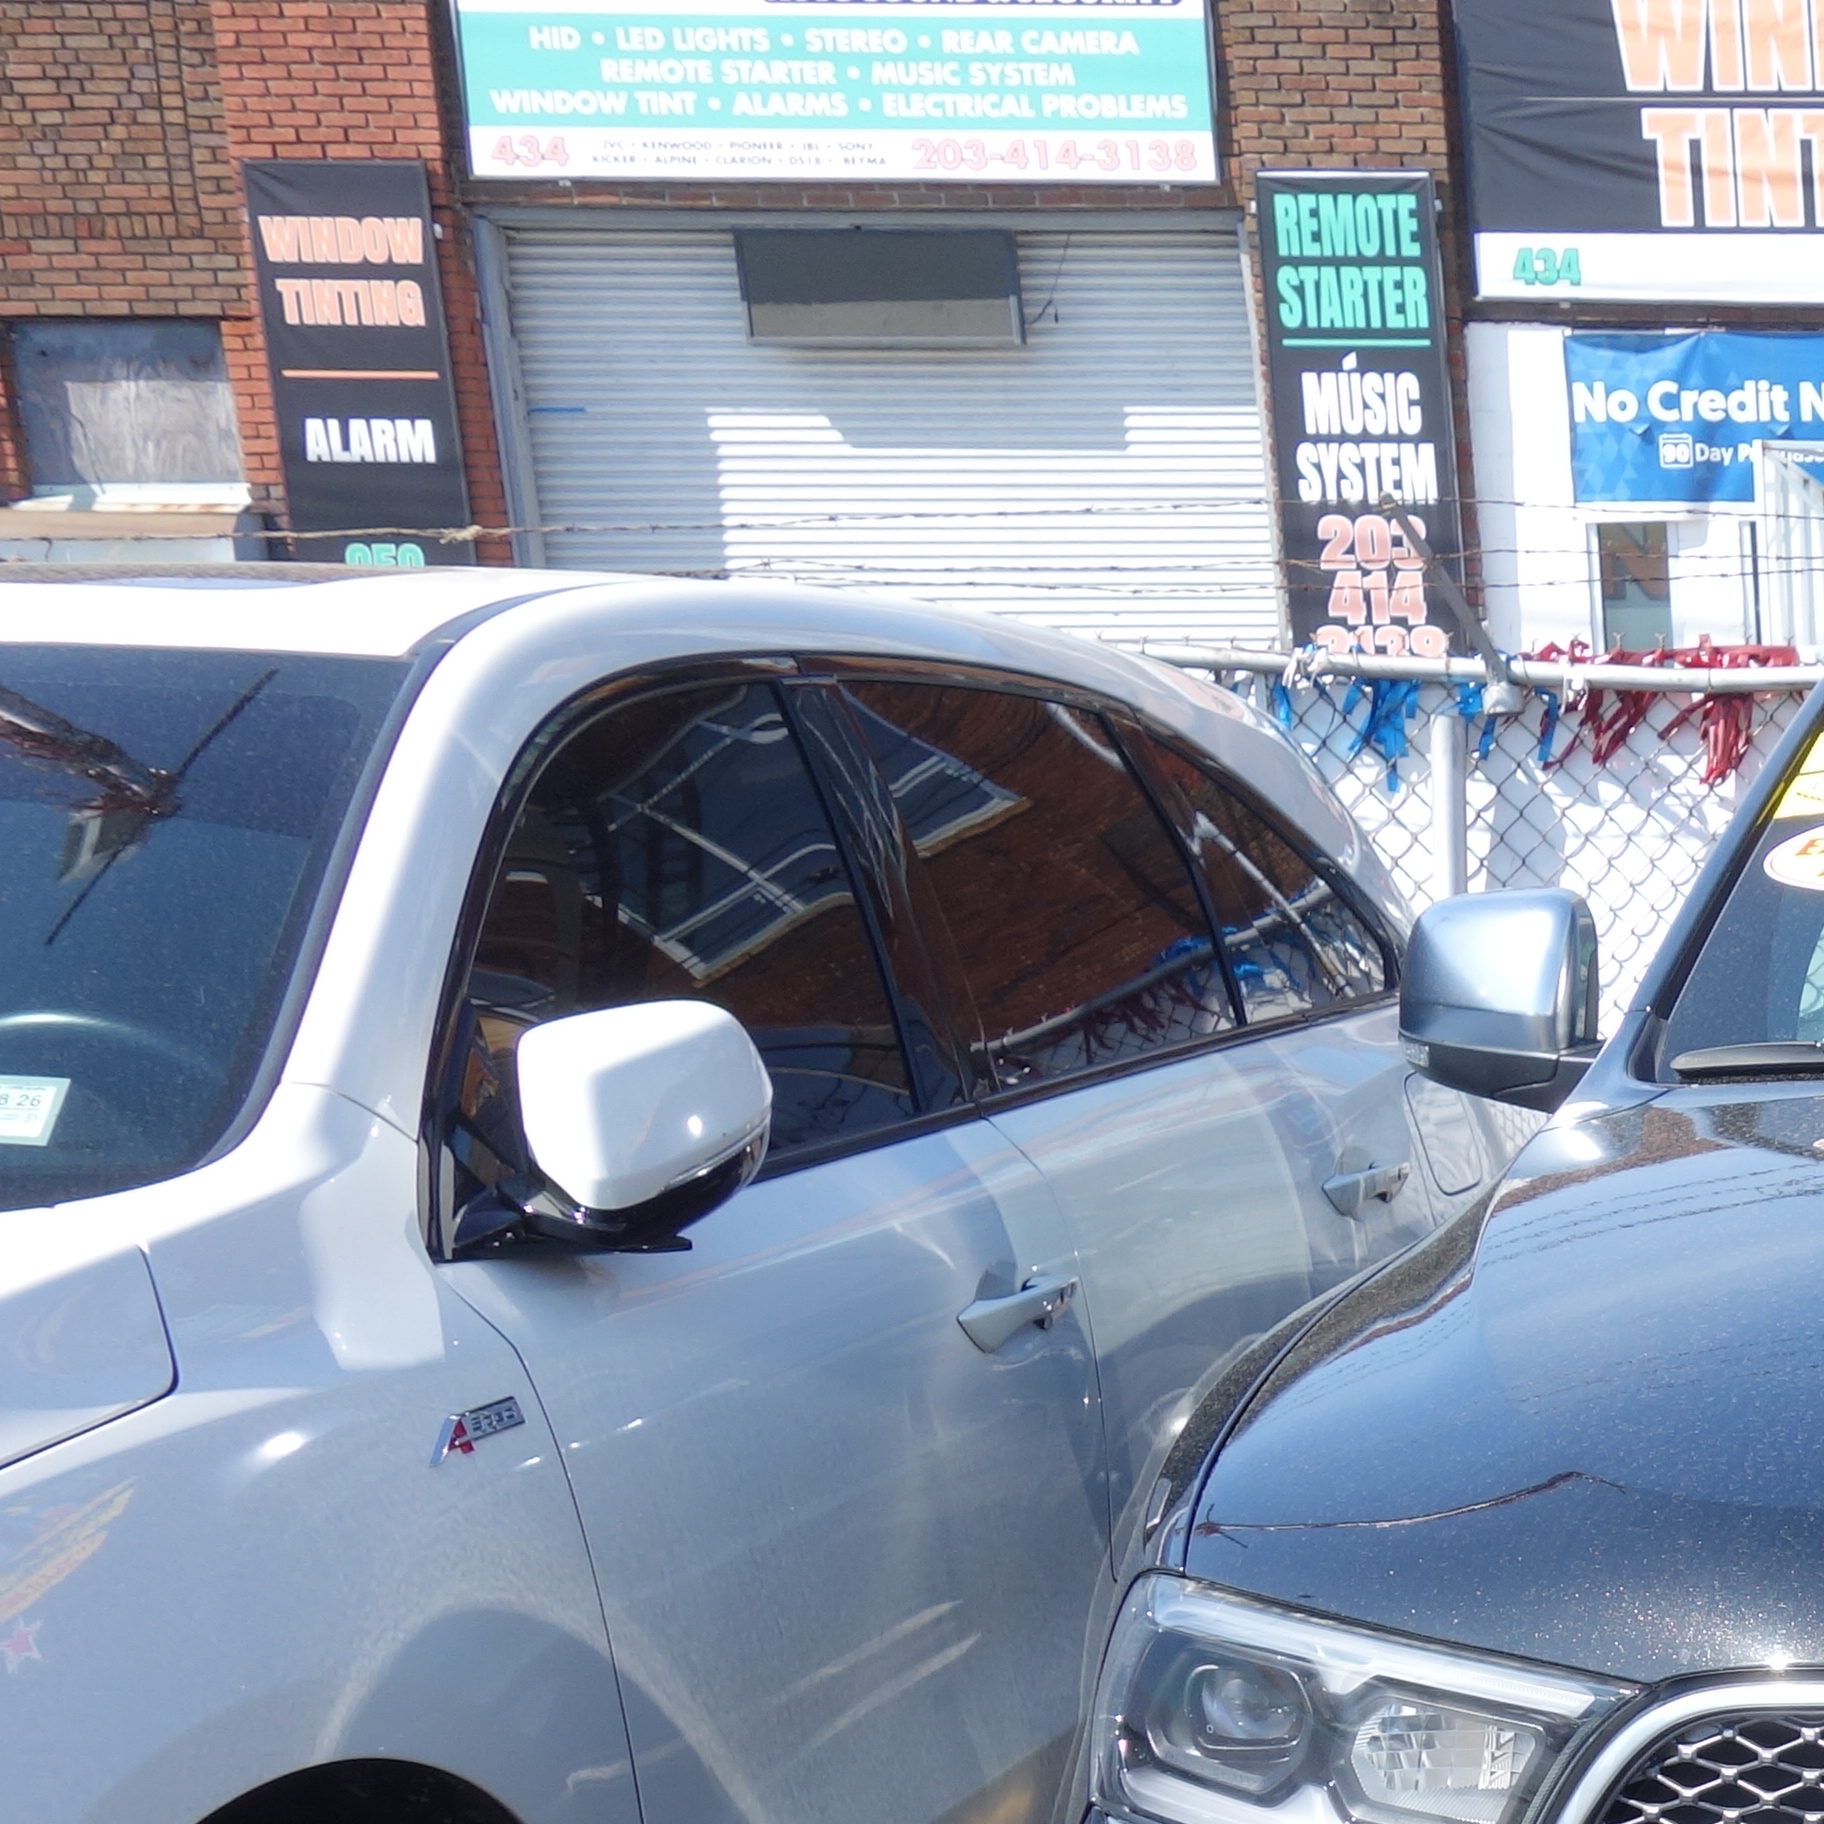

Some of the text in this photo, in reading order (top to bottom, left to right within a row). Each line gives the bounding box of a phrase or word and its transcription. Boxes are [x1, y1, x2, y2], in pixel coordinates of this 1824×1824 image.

[529, 26, 1140, 55] HID LED LIGHTS STEREO REAR CAMERA
[601, 59, 1076, 86] REMOTE STARTER MUSIC SYSTEM
[489, 89, 1188, 119] WINDOW TINT ALARMS ELECTRICAL PROBLEMS
[491, 135, 569, 168] 434
[592, 155, 636, 164] KICKER
[655, 155, 698, 164] ALPINE
[715, 156, 772, 165] CLARION
[843, 157, 887, 166] BEYMA
[603, 141, 873, 151] JVC KENWOOD PIONEER JBL SONY
[911, 138, 1198, 171] 203-414-3138
[257, 216, 424, 265] WINDOW
[1273, 193, 1421, 257] REMOTE
[1513, 247, 1582, 287] 434
[274, 279, 427, 327] TINTING
[1276, 265, 1430, 329] STARTER
[1572, 381, 1639, 423] No
[1648, 380, 1790, 423] Credit
[304, 417, 437, 465] ALARM
[1695, 444, 1734, 467] Day
[1296, 442, 1439, 505] SYSTEM
[1317, 514, 1427, 571] 203
[1328, 570, 1427, 625] 414
[16, 1094, 42, 1107] 26
